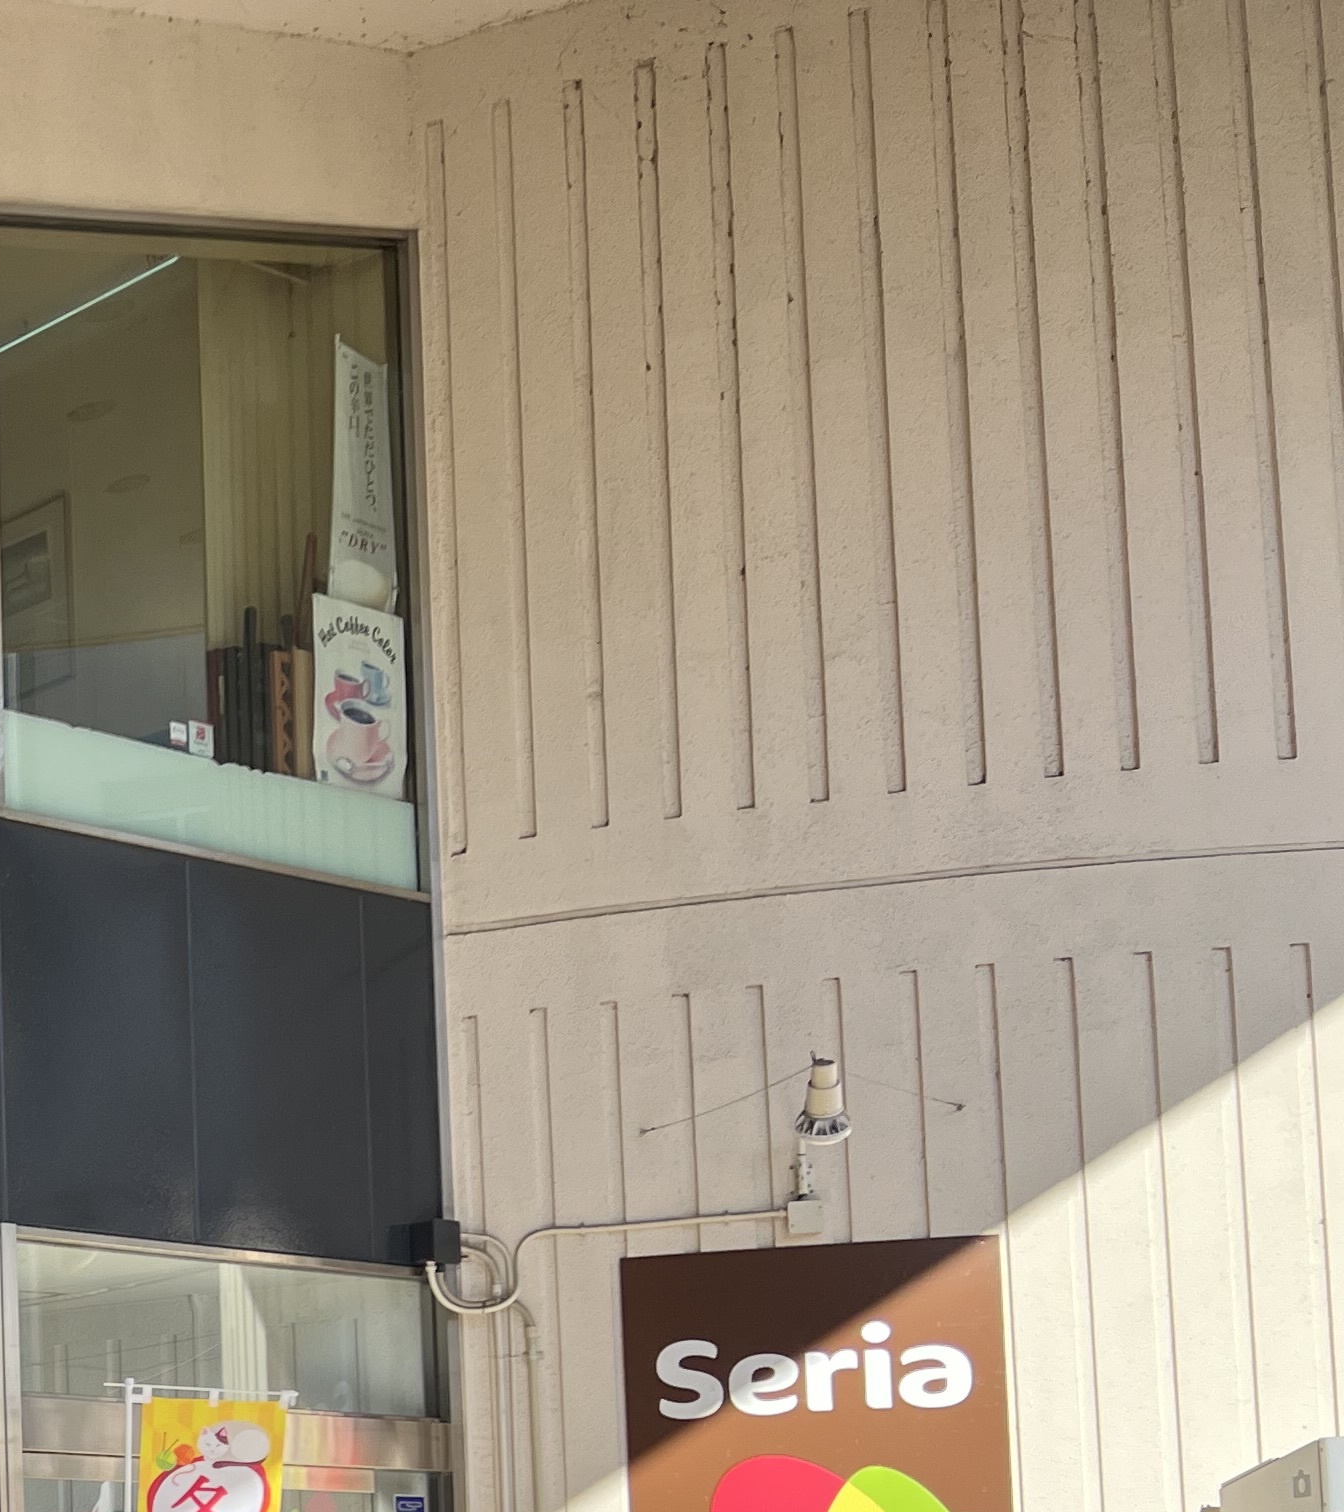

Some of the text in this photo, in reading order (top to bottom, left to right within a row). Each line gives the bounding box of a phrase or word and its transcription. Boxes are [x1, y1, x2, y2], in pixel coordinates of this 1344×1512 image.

[335, 615, 371, 638] Coffee
[371, 626, 398, 665] Color
[655, 1320, 974, 1420] Seria
